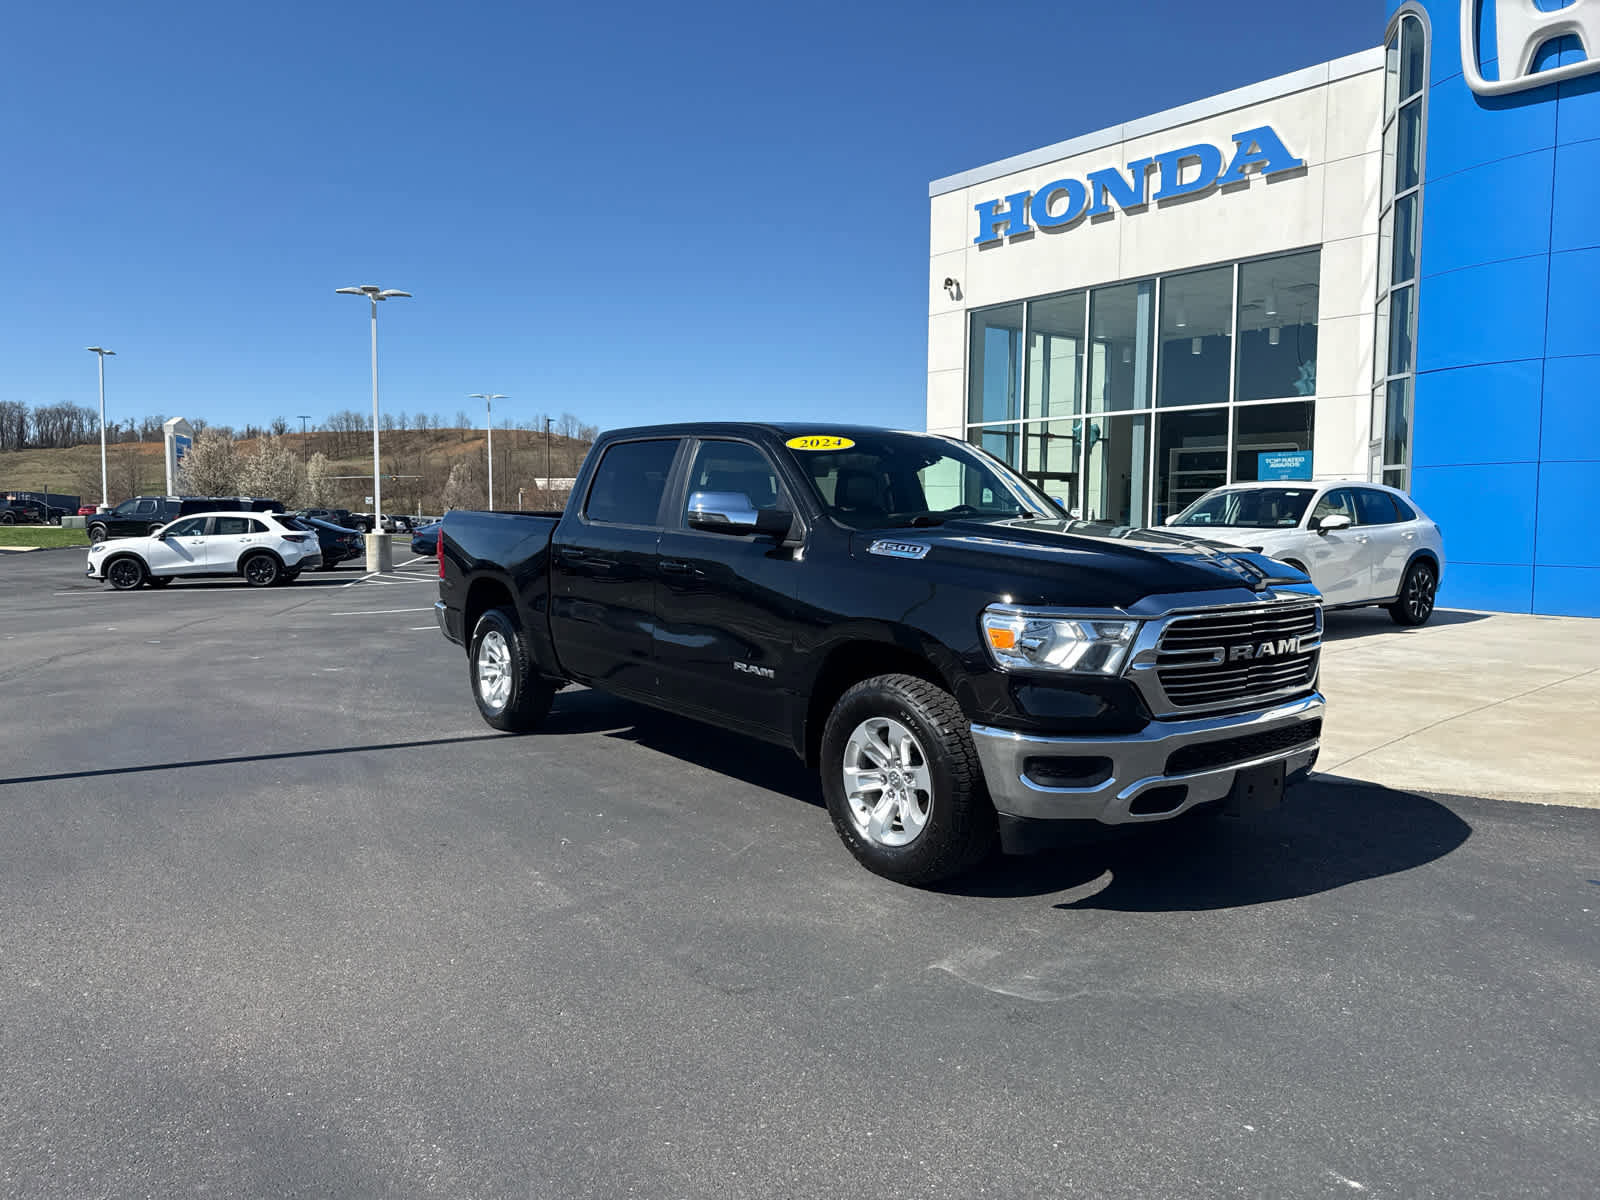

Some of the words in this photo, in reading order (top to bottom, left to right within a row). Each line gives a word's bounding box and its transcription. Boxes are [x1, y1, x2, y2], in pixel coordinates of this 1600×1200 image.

[973, 125, 1306, 248] HONDA
[801, 439, 842, 448] 2024
[1230, 639, 1296, 660] RAM
[733, 661, 775, 680] RAM
